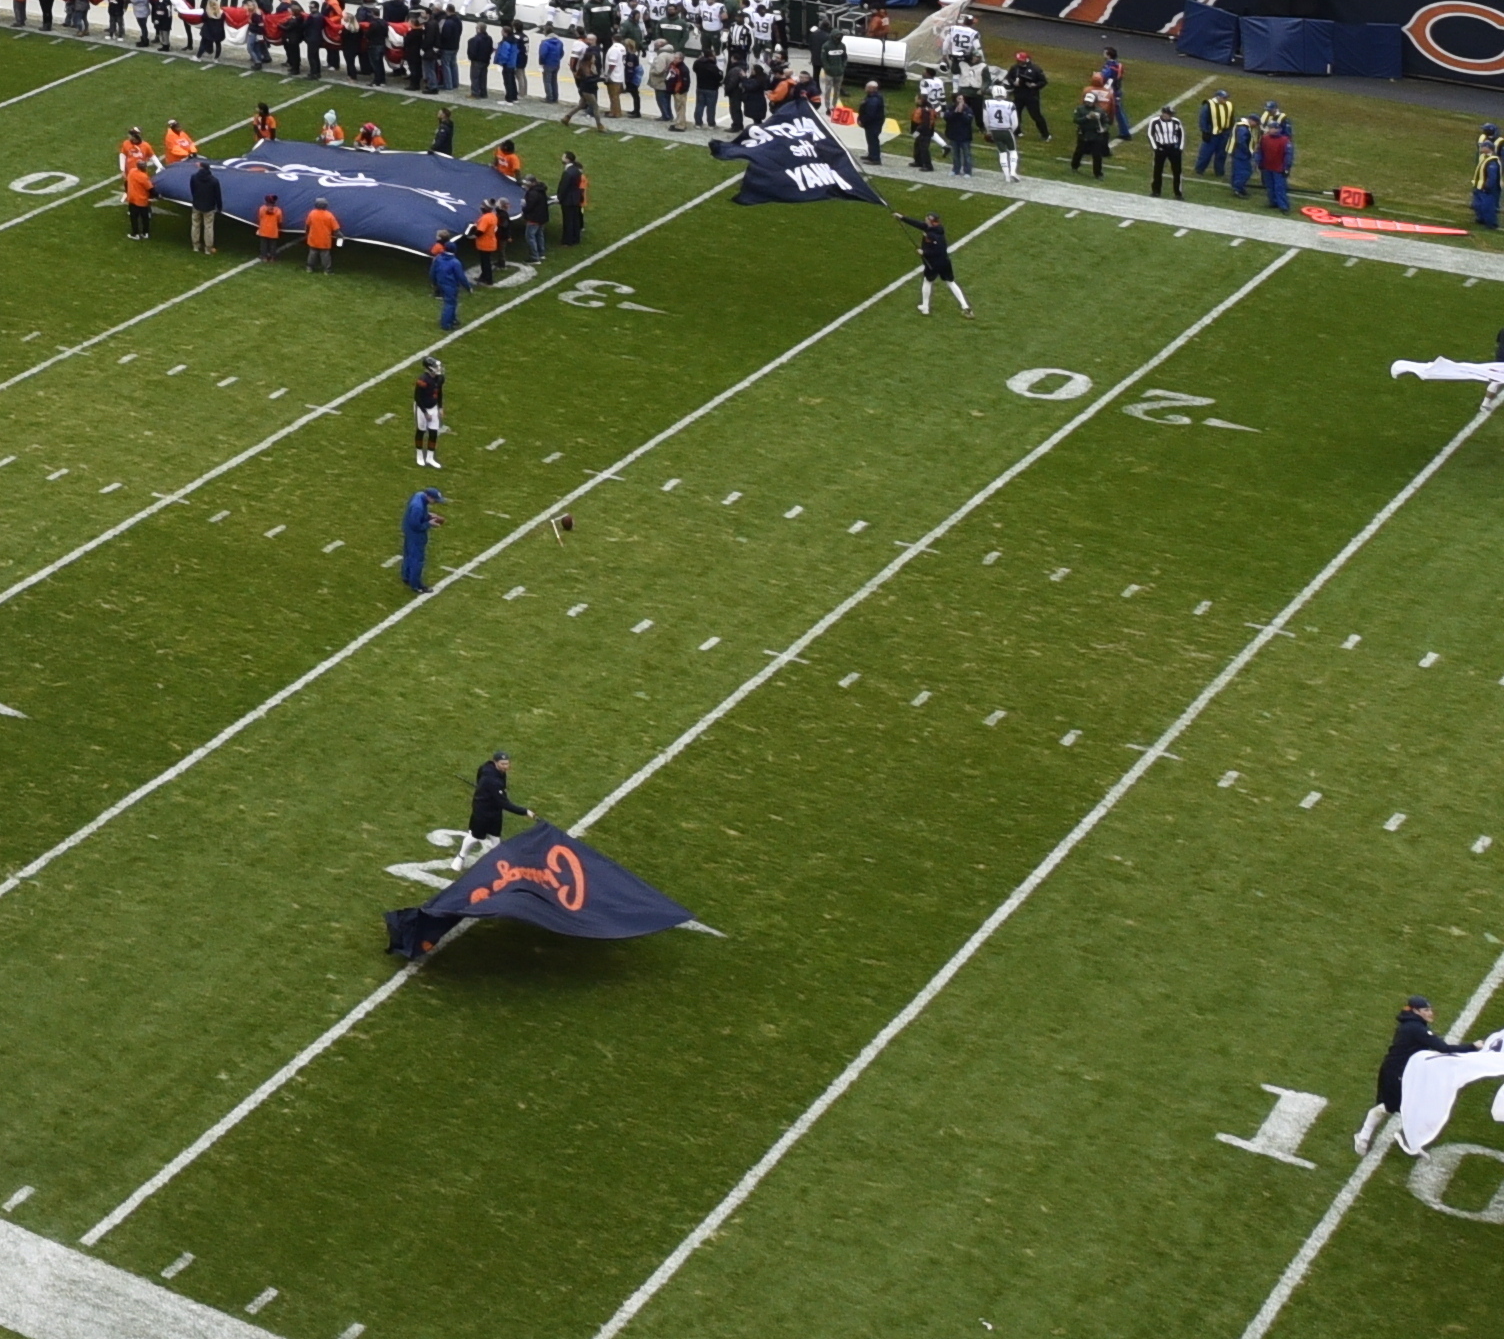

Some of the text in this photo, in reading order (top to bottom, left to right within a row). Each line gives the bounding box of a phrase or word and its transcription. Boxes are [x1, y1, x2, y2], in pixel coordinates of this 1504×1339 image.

[953, 34, 971, 48] 42
[993, 108, 1004, 124] 4
[1341, 189, 1363, 207] 20
